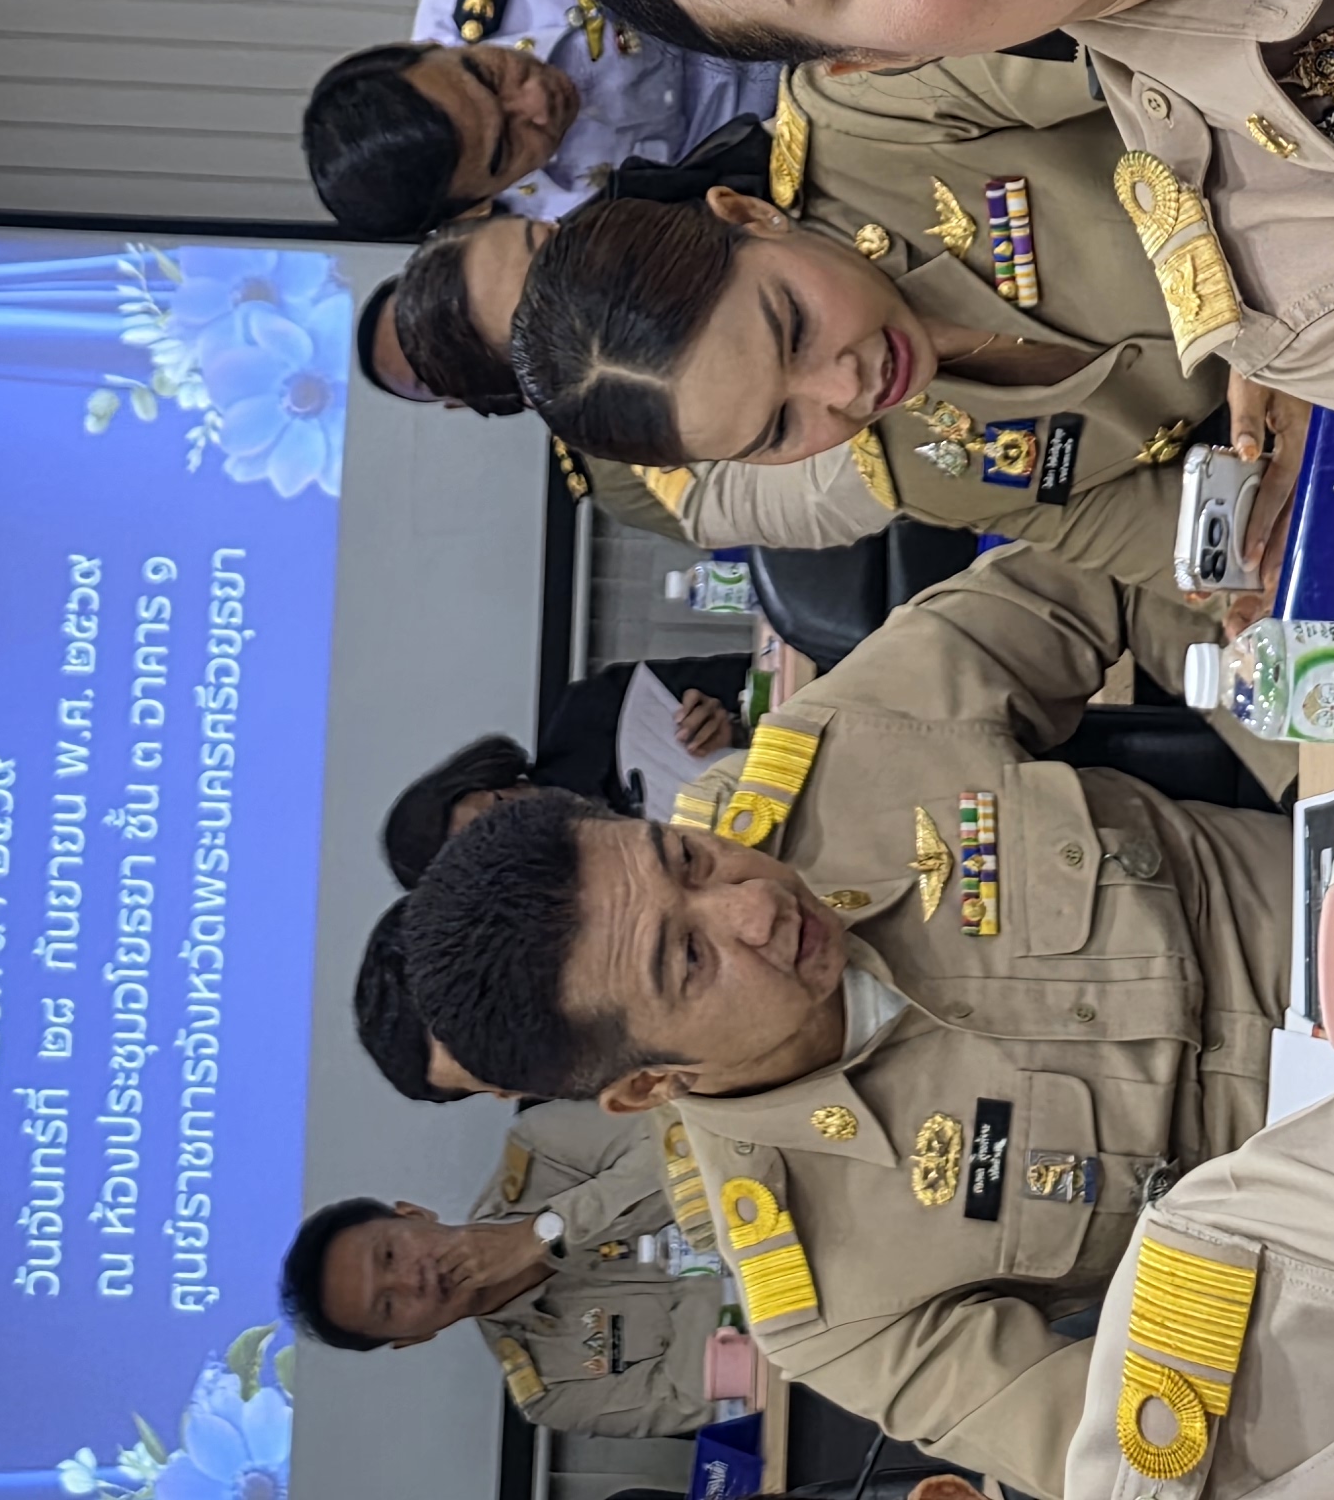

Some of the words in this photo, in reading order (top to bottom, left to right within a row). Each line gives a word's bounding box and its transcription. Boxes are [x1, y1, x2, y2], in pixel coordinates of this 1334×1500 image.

[62, 555, 101, 673] ๒๕๖๙
[132, 596, 171, 726] อาคาร
[55, 688, 97, 777] พ.ศ.
[133, 742, 161, 768] ๓
[103, 785, 159, 839] ชั้น
[33, 795, 86, 969] กันยายน
[164, 549, 255, 1311] ศูนย์ราชการจังหวัดพระนครศรีอยุธยา
[38, 998, 74, 1057] ๒๘
[89, 856, 158, 1234] ห้องประชุมอโยธยา
[13, 1088, 69, 1295] วันจันทร์ที่
[99, 1254, 133, 1296] ณ
